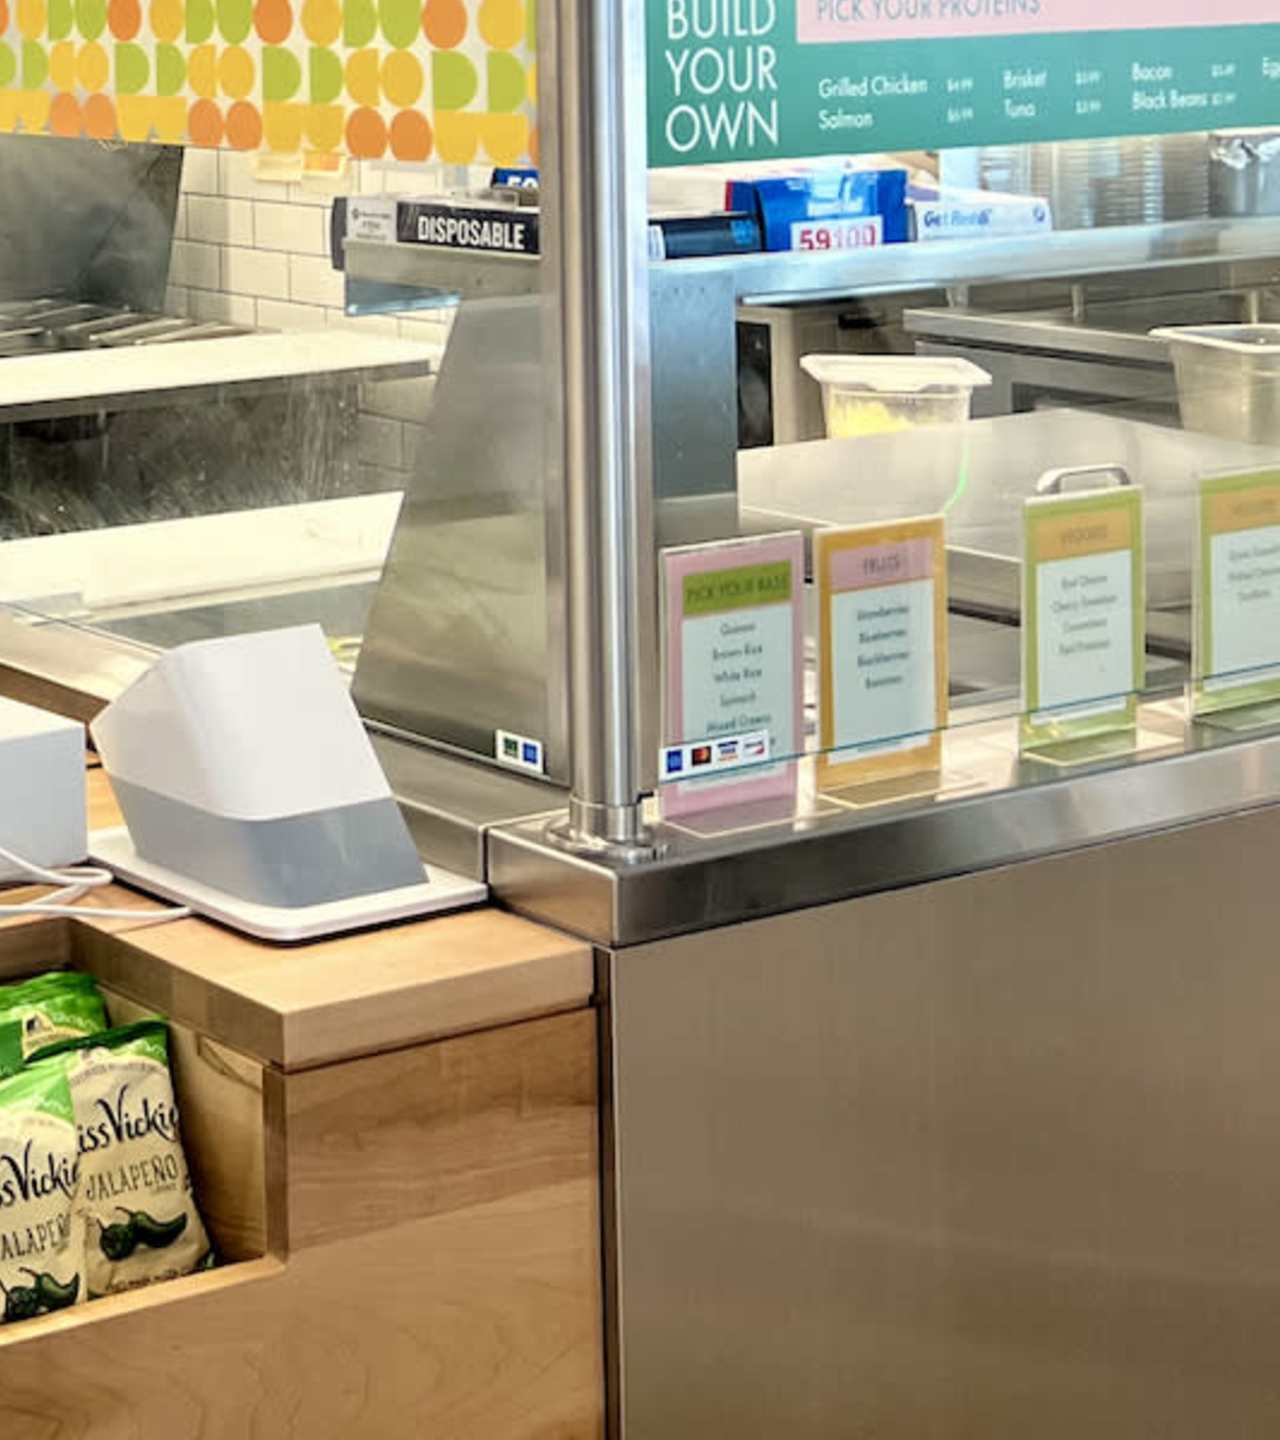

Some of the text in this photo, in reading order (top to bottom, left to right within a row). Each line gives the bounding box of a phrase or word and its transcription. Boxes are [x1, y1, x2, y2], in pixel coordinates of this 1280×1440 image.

[664, 44, 778, 97] YOUR
[1002, 68, 1048, 90] Brisket
[1132, 62, 1174, 82] Bacon
[818, 71, 929, 99] Grilled Chicken
[1004, 98, 1037, 118] Tuna
[1132, 89, 1209, 111] Black Beans
[665, 98, 779, 153] OWN
[818, 108, 874, 131] Salmon
[416, 214, 526, 251] DISPOSABLE
[77, 1123, 110, 1157] iss
[86, 1153, 180, 1203] JALAPEÑO
